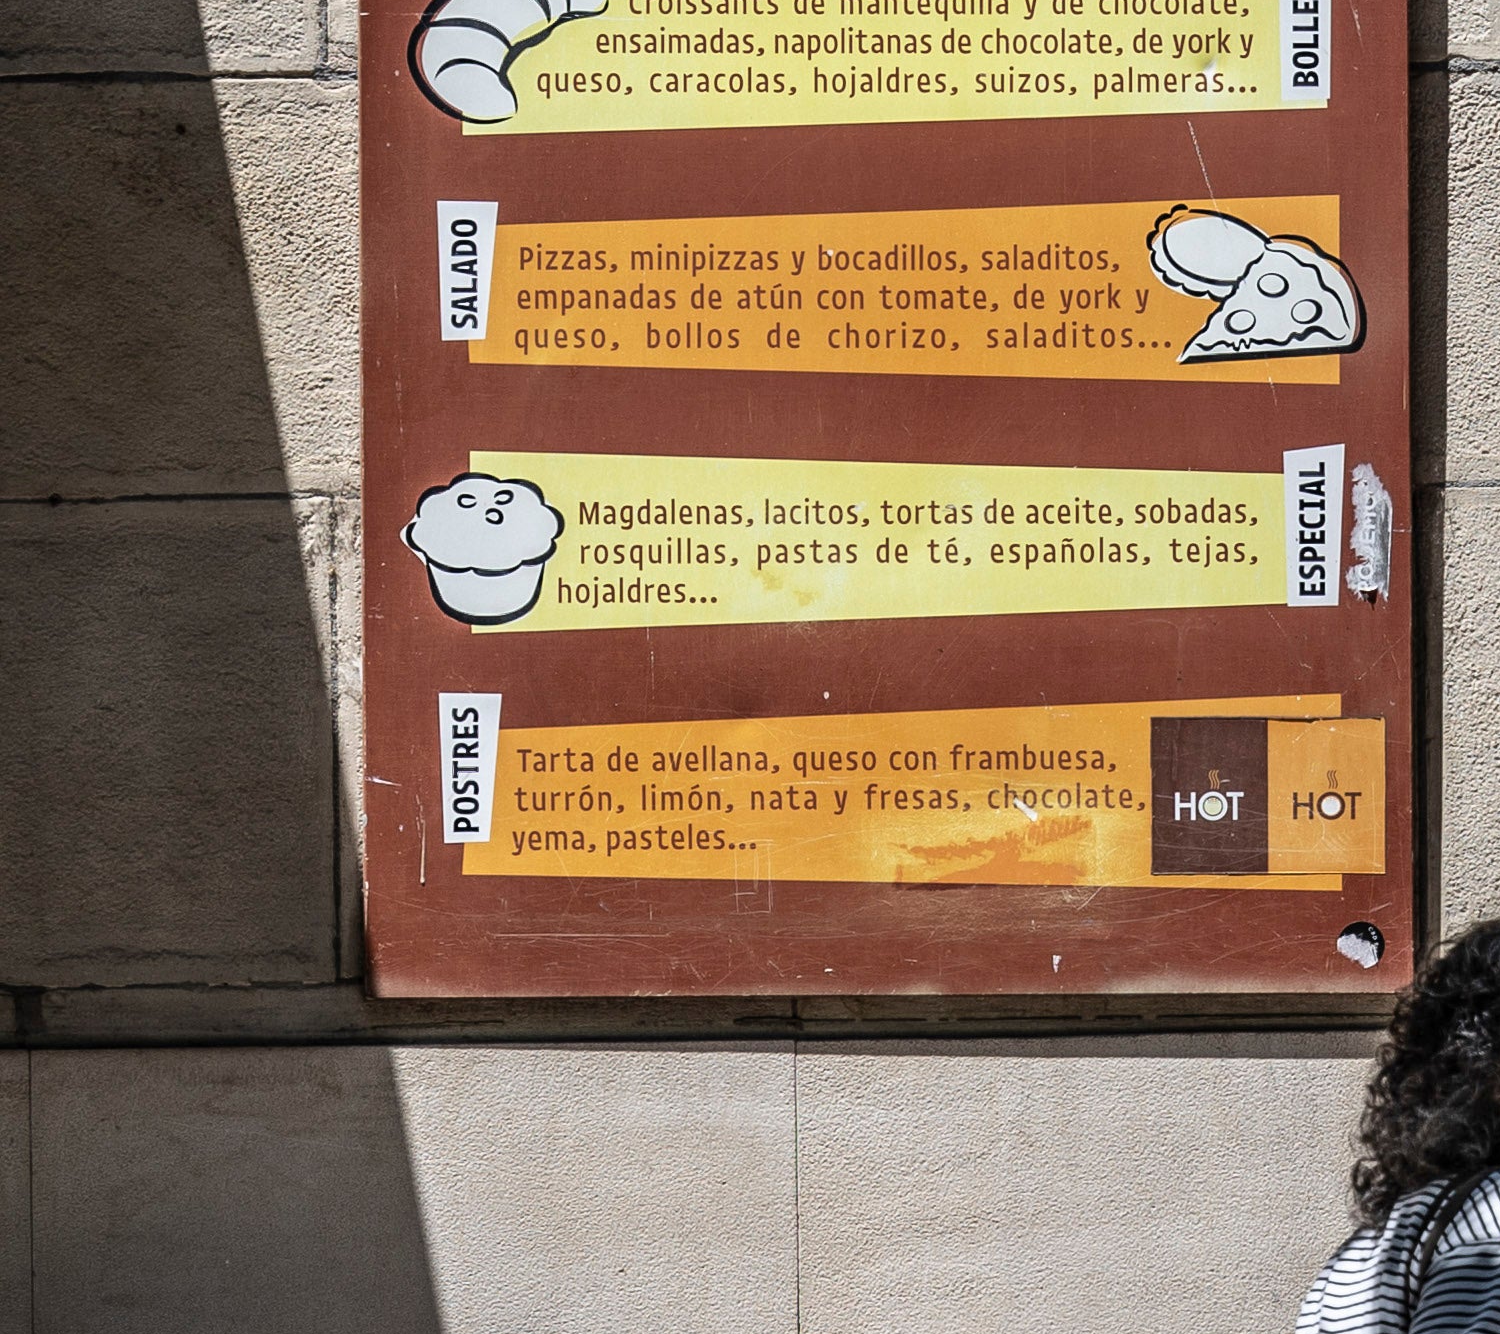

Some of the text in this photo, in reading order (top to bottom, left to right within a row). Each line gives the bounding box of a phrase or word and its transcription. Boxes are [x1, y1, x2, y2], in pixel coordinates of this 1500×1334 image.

[595, 26, 1254, 61] ensaimadas, napolitanas de chocolate, de york y
[536, 63, 1258, 100] queso, caracolas, hojaldres, suizos, palmeras...
[451, 217, 480, 331] SALADO
[519, 241, 1120, 279] Pizzas, minipizzas y bocadillos, saladitos,
[517, 282, 1150, 317] empanadas de atún con tomate, de york y
[514, 320, 1172, 355] queso, bollos de chorizo, saladitos...
[579, 496, 1258, 531] Magdalenas, lacitos, tortas de aceite, sobadas,
[1298, 460, 1328, 599] ESPECIAL
[580, 535, 1258, 571] rosquillas, pastas de té, españolas, tejas,
[558, 576, 718, 609] hojaldres...
[452, 705, 481, 835] POSTRES
[516, 743, 1117, 779] Tarta de avellana, queso con frambuesa,
[513, 780, 1146, 818] turrón, limón, nata y fresas, chocolate,
[1174, 790, 1245, 821] HOT
[1292, 790, 1363, 821] HOT
[511, 822, 757, 858] yema, pasteles...
